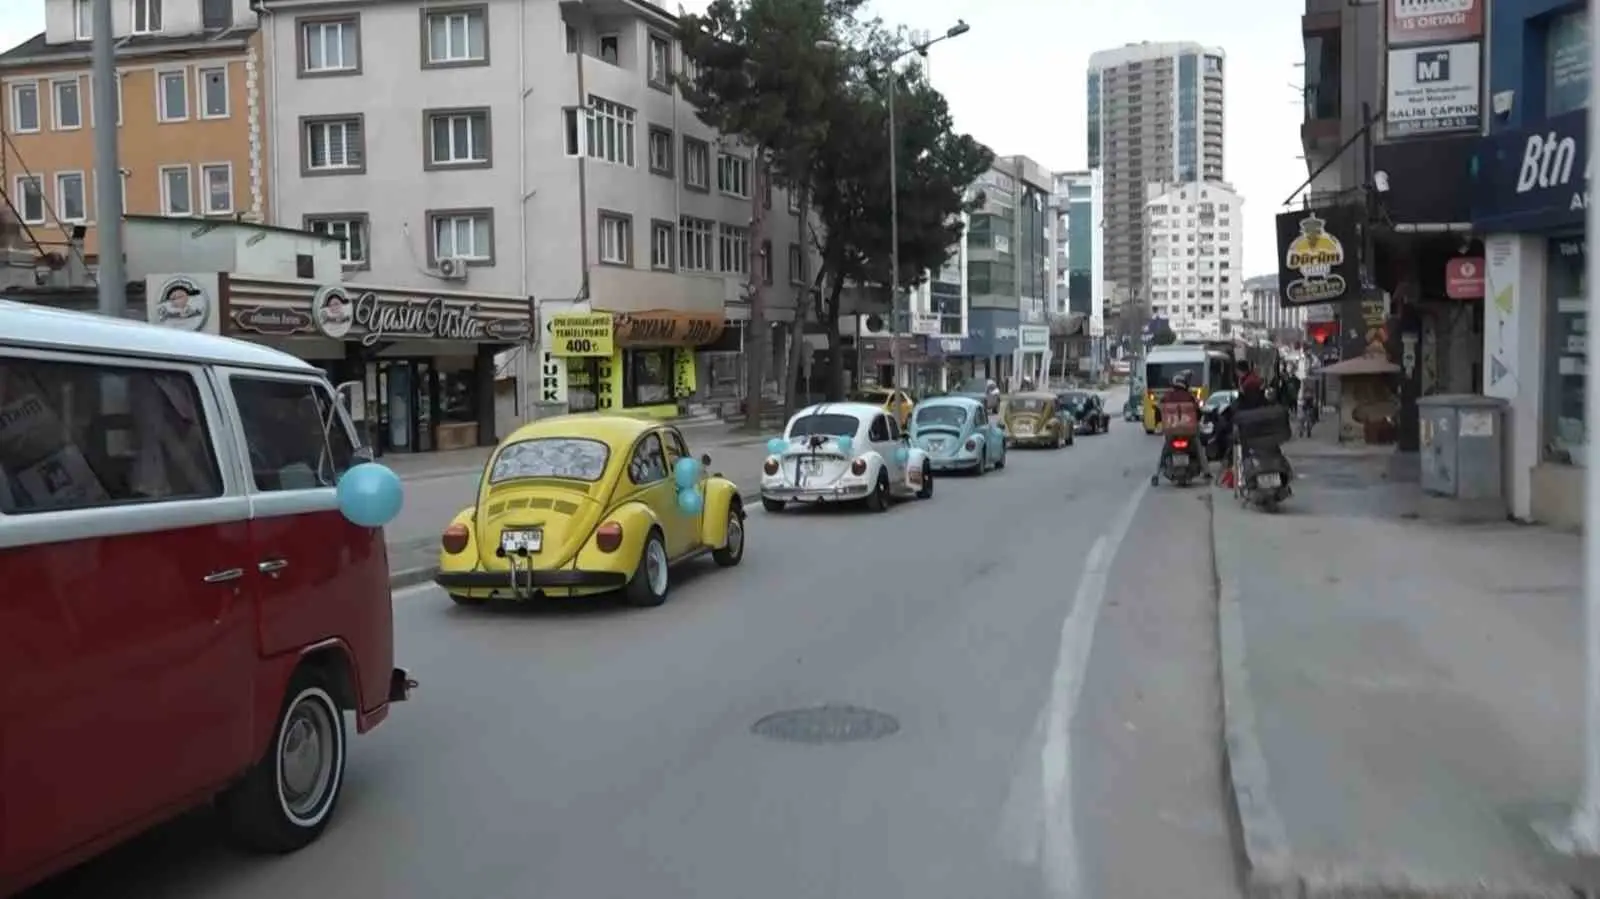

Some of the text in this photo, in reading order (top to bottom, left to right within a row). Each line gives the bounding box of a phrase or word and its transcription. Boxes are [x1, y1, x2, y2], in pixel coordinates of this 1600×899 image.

[1516, 131, 1576, 192] Btn
[566, 339, 591, 353] 400
[600, 358, 612, 409] URU
